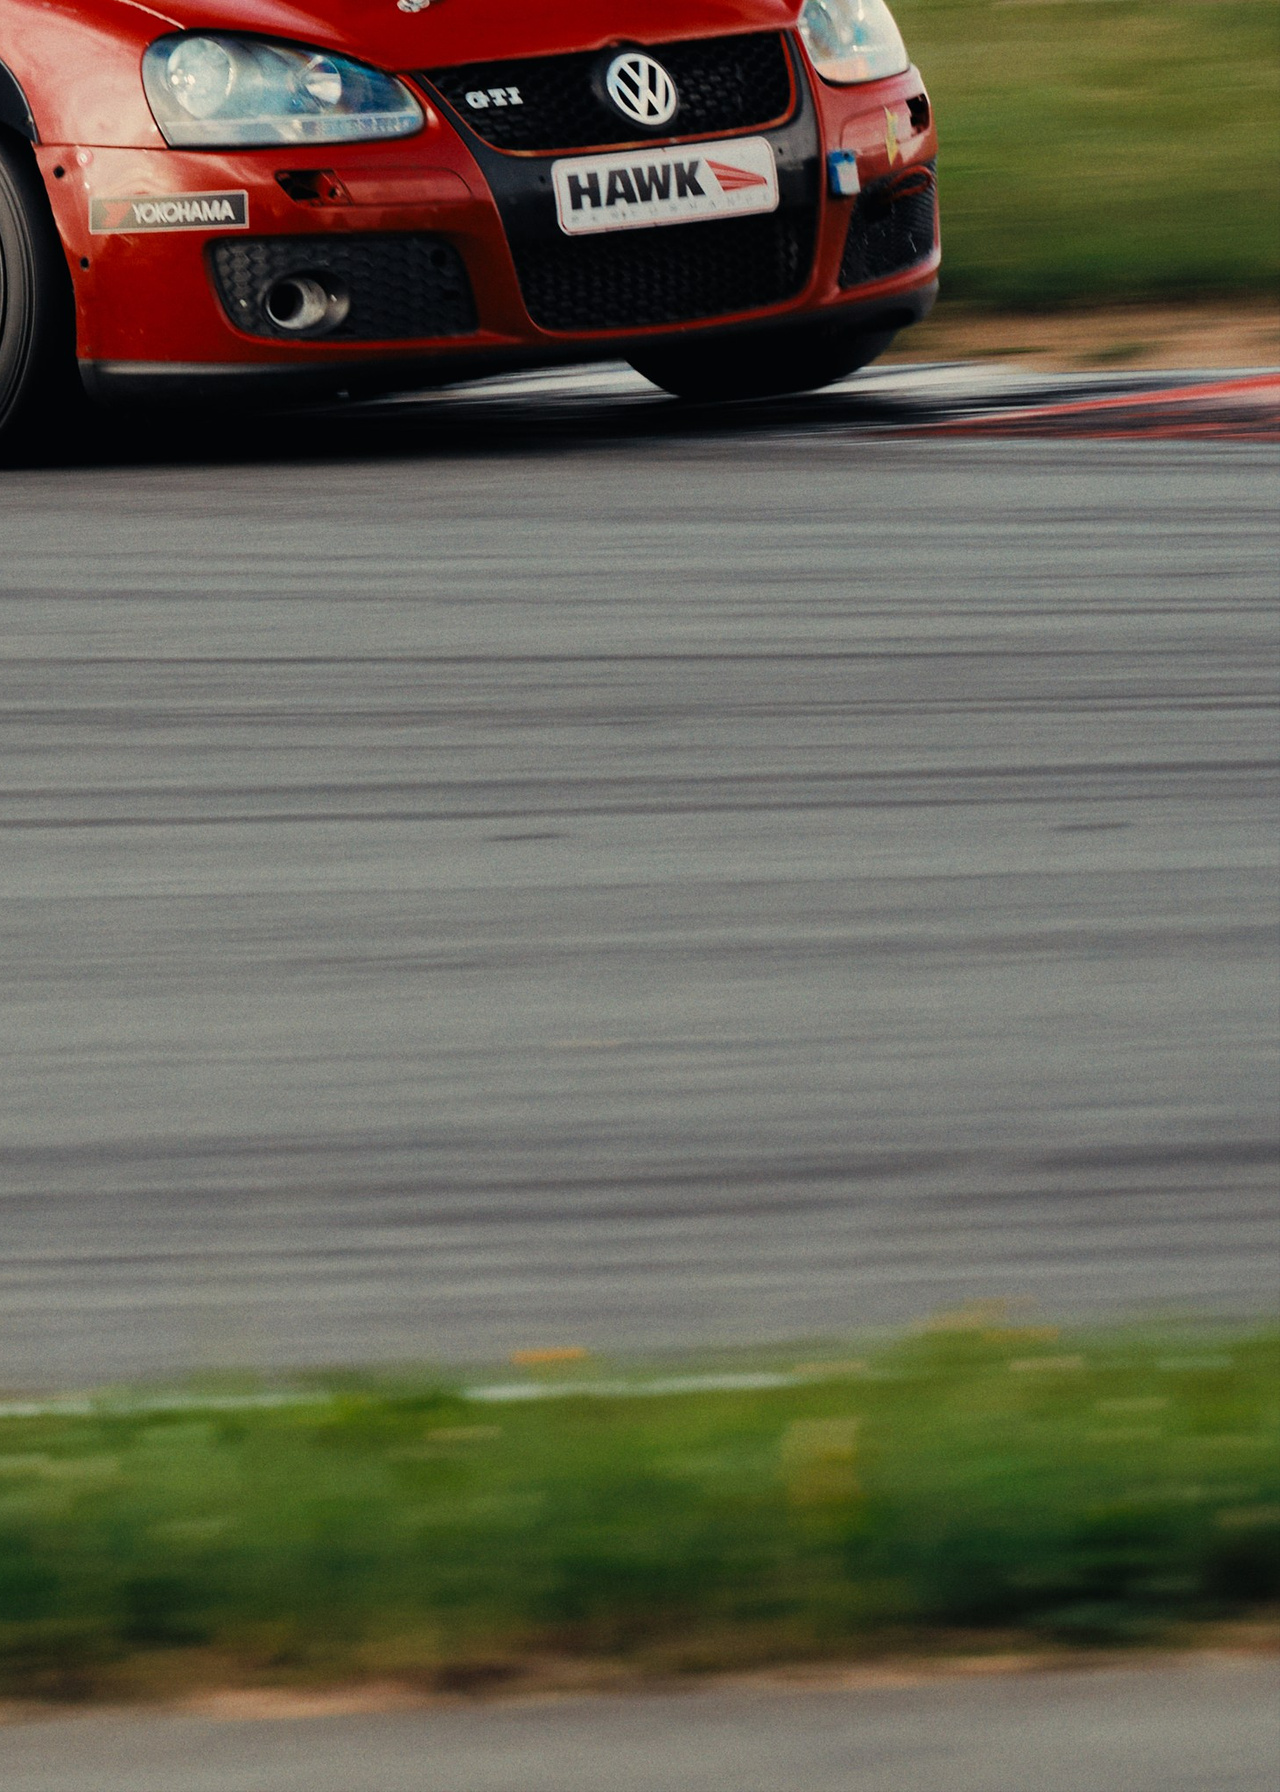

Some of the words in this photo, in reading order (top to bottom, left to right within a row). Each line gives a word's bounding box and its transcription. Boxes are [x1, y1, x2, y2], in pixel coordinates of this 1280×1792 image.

[465, 86, 524, 109] GTI
[567, 160, 707, 211] HAWK
[131, 199, 236, 225] YOKOHAMA
